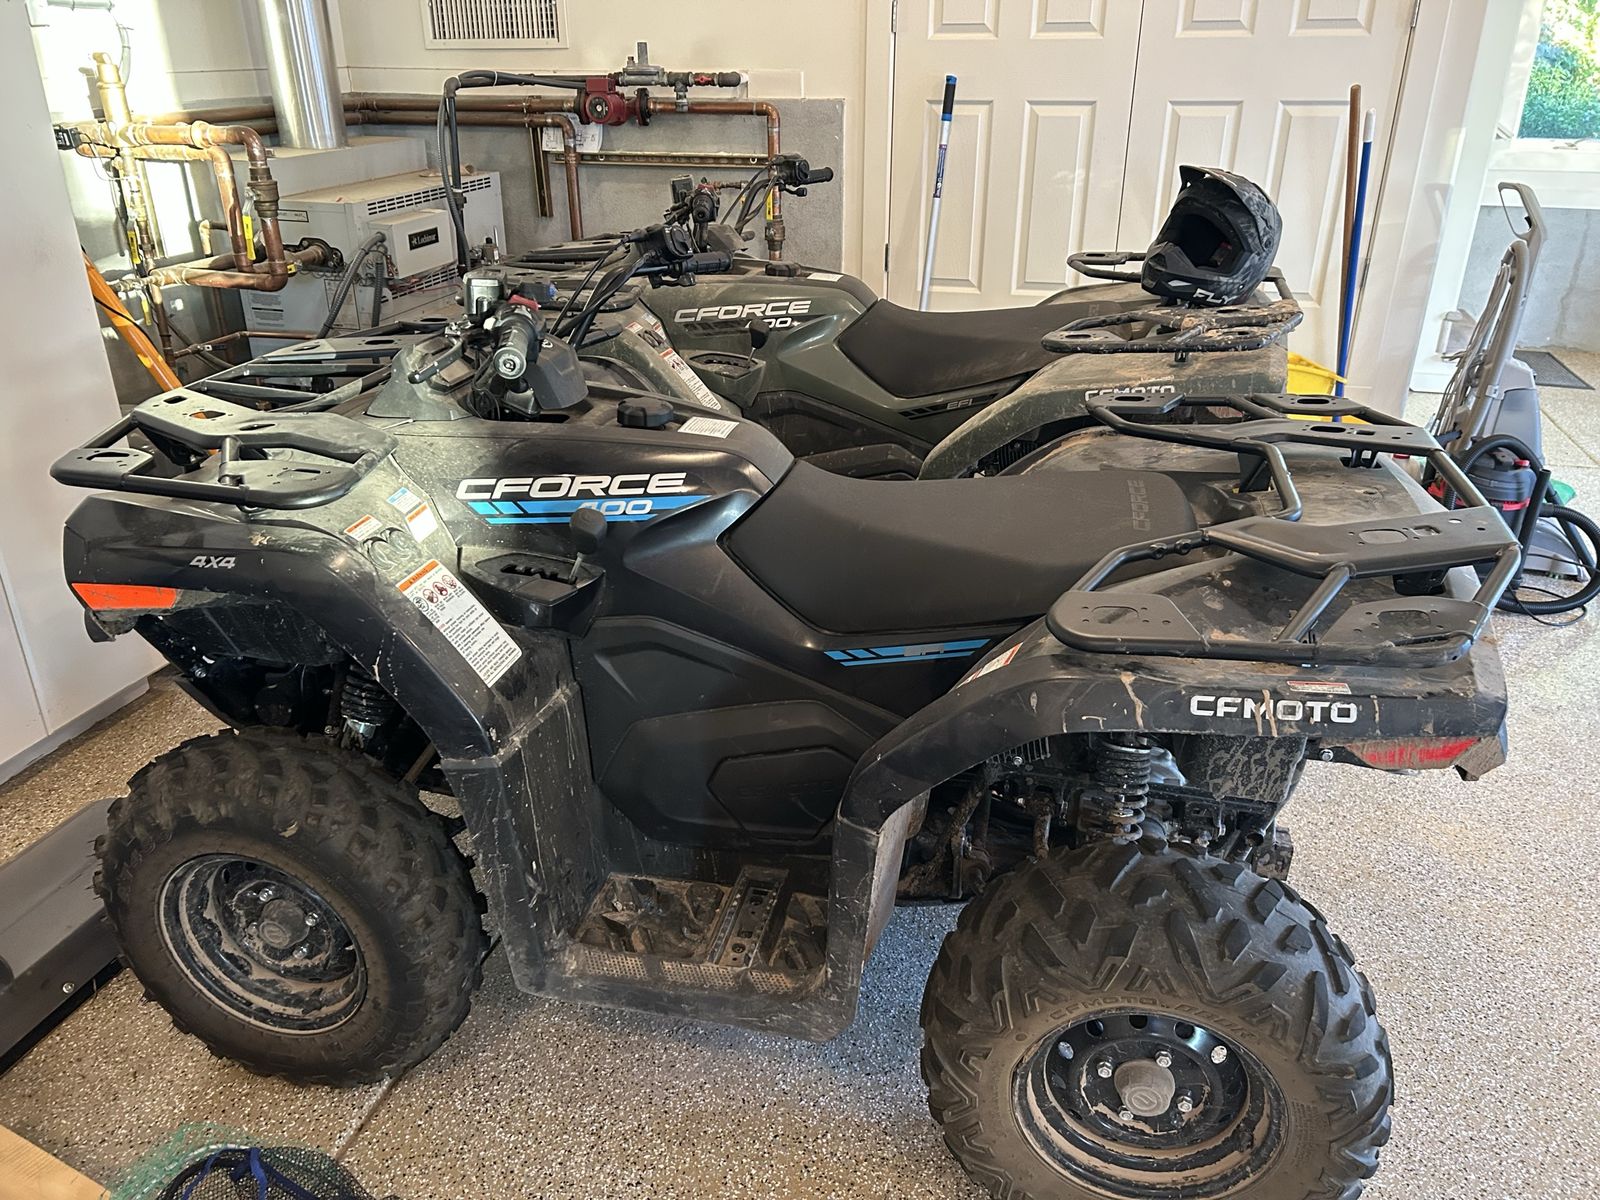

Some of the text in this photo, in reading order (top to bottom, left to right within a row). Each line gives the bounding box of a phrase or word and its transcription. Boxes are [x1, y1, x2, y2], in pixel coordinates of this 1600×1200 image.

[1193, 288, 1238, 304] FLY
[673, 301, 811, 323] CFORCE
[946, 399, 973, 410] EFI
[455, 472, 687, 500] CFORCE
[1189, 695, 1358, 723] CFMOTO
